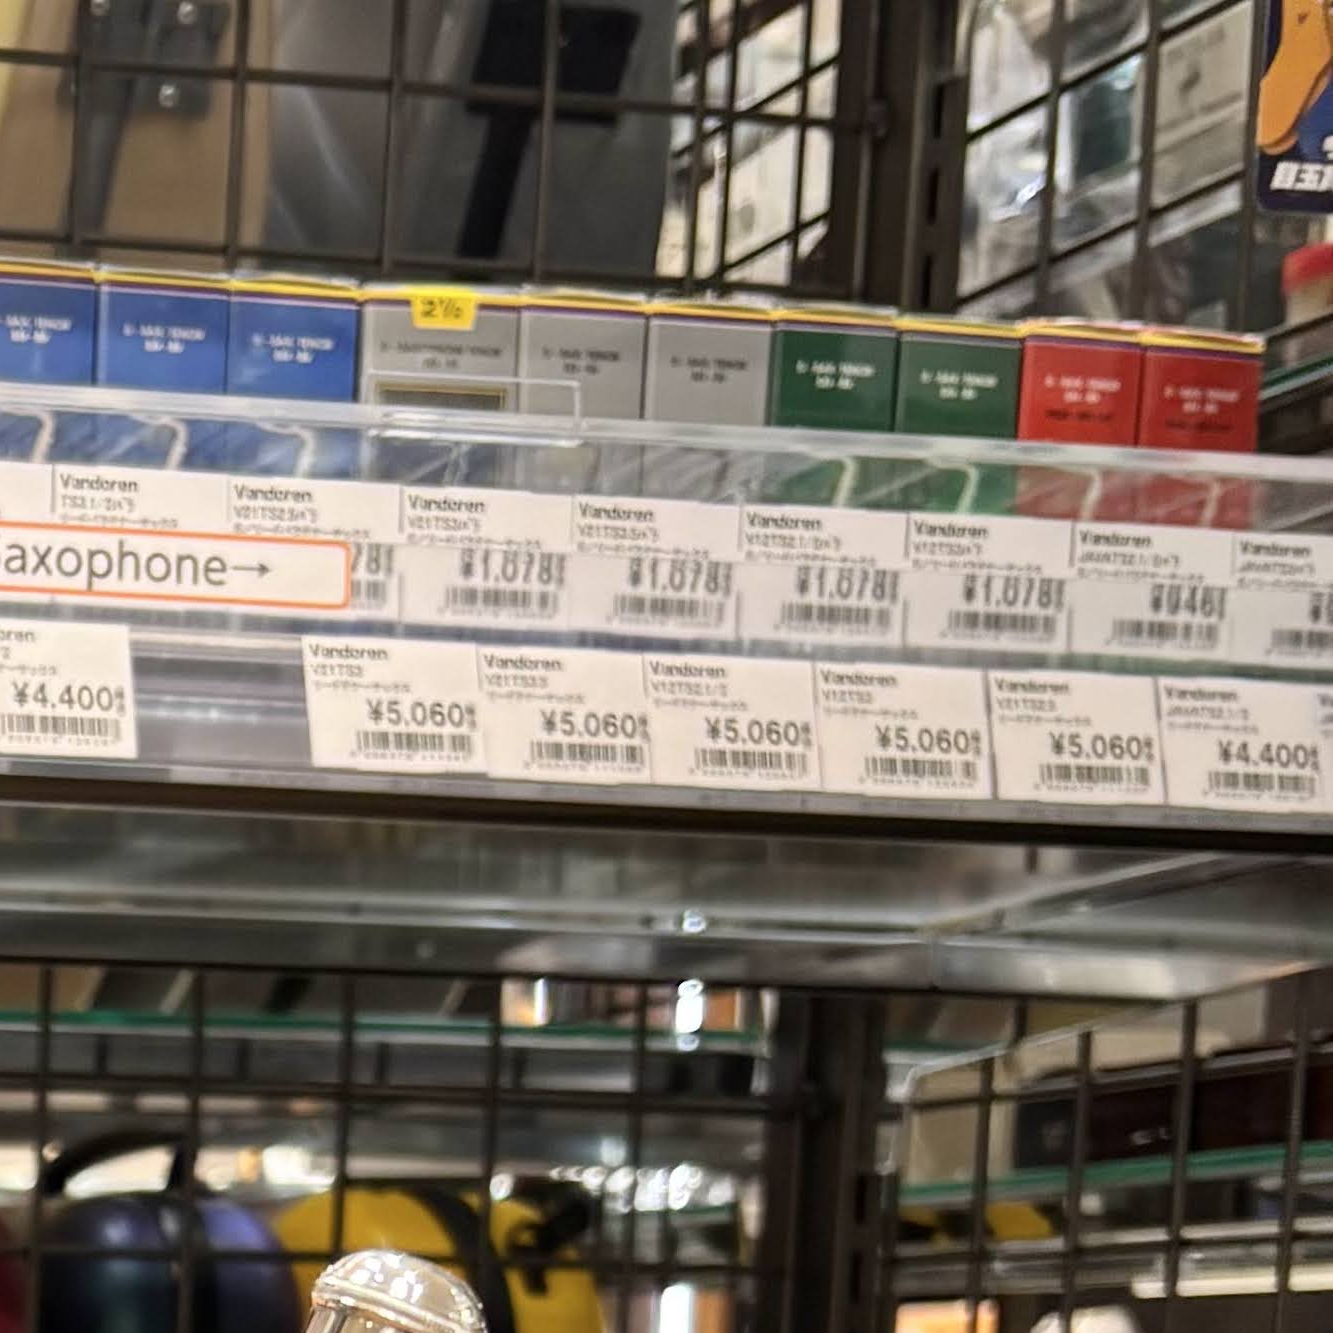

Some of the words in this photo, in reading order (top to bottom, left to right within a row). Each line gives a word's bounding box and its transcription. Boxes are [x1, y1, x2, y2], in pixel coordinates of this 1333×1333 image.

[408, 494, 485, 512] Vandoren
[579, 503, 654, 522] Vandoren
[309, 643, 388, 660] Vandoren
[484, 654, 563, 672] Vandoren
[650, 661, 726, 679] Vandoren
[13, 681, 113, 711] ¥4,400
[366, 698, 464, 729] ¥5,060
[540, 708, 638, 739] ¥5,060
[704, 716, 800, 746] ¥5,060
[876, 724, 971, 754] ¥5,060
